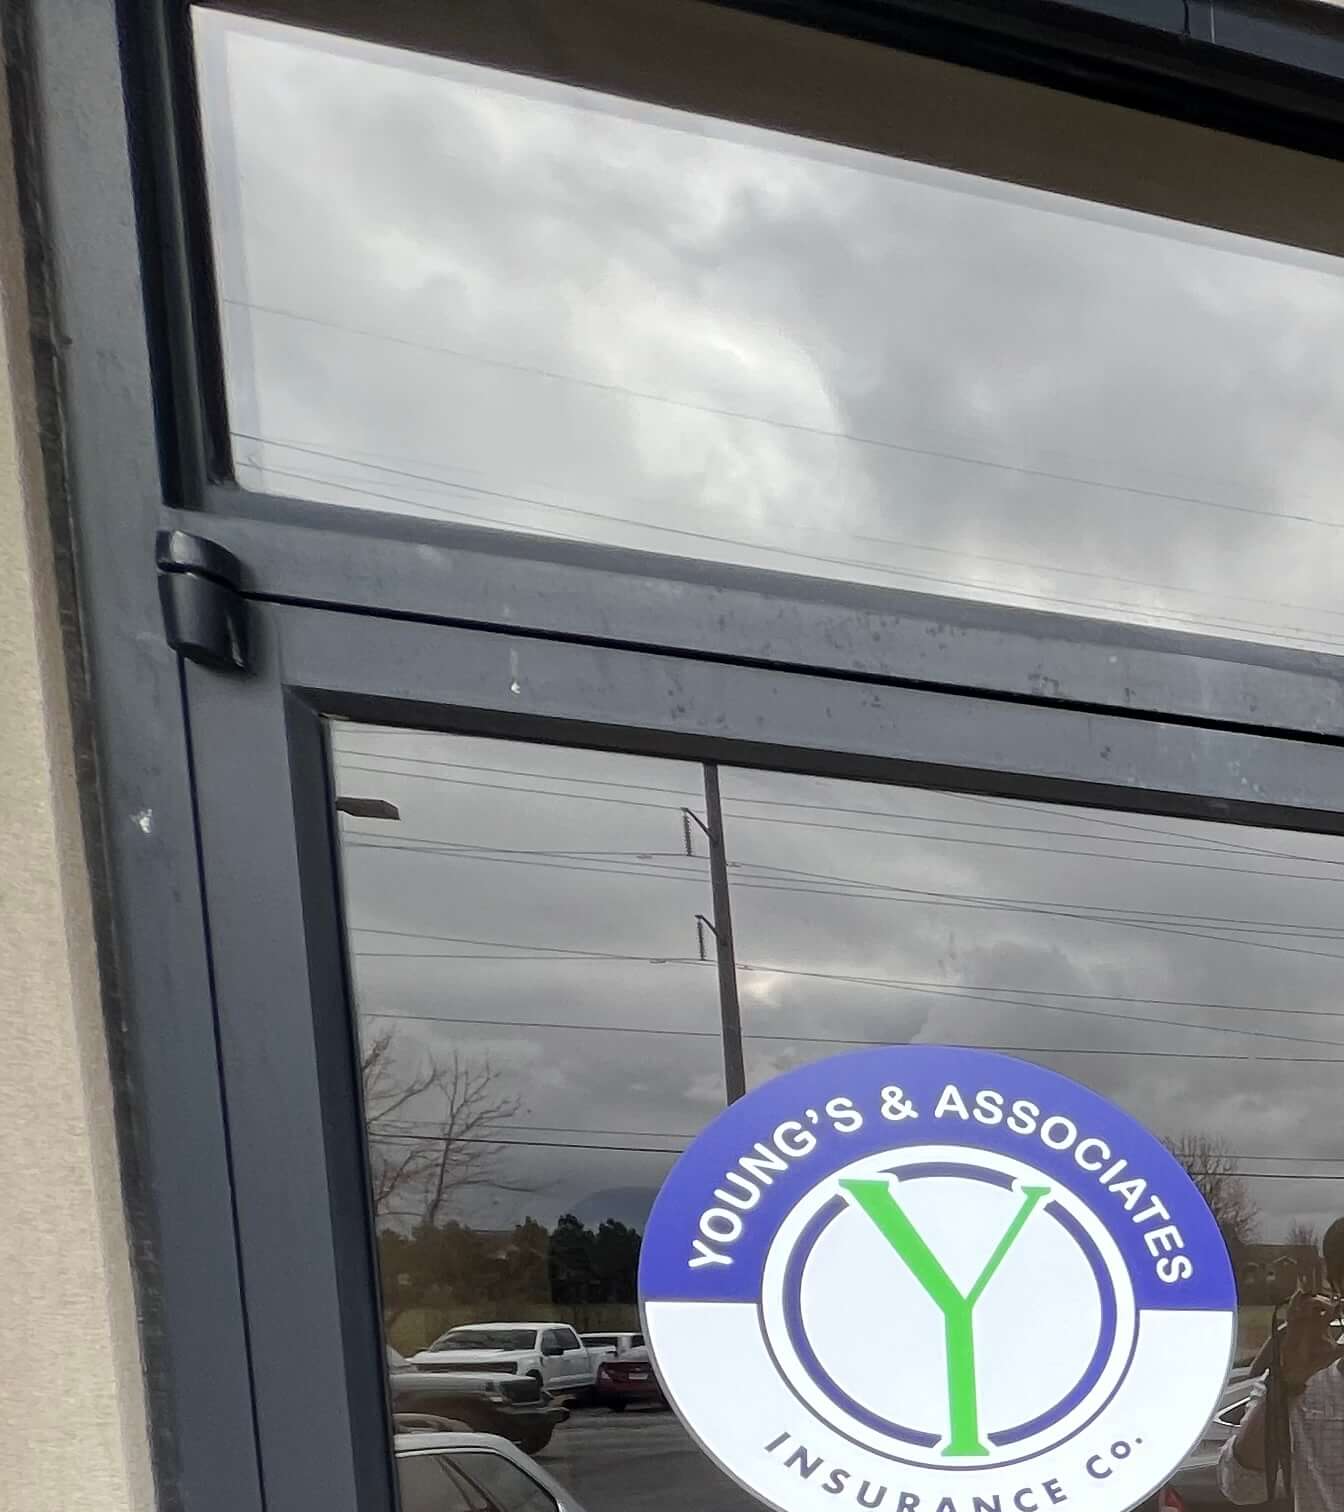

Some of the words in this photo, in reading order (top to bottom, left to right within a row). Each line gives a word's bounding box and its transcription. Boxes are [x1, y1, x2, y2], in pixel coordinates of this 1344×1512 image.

[687, 1096, 864, 1268] YOUNG'S
[880, 1085, 921, 1121] &
[934, 1084, 1193, 1284] ASSOCIATES
